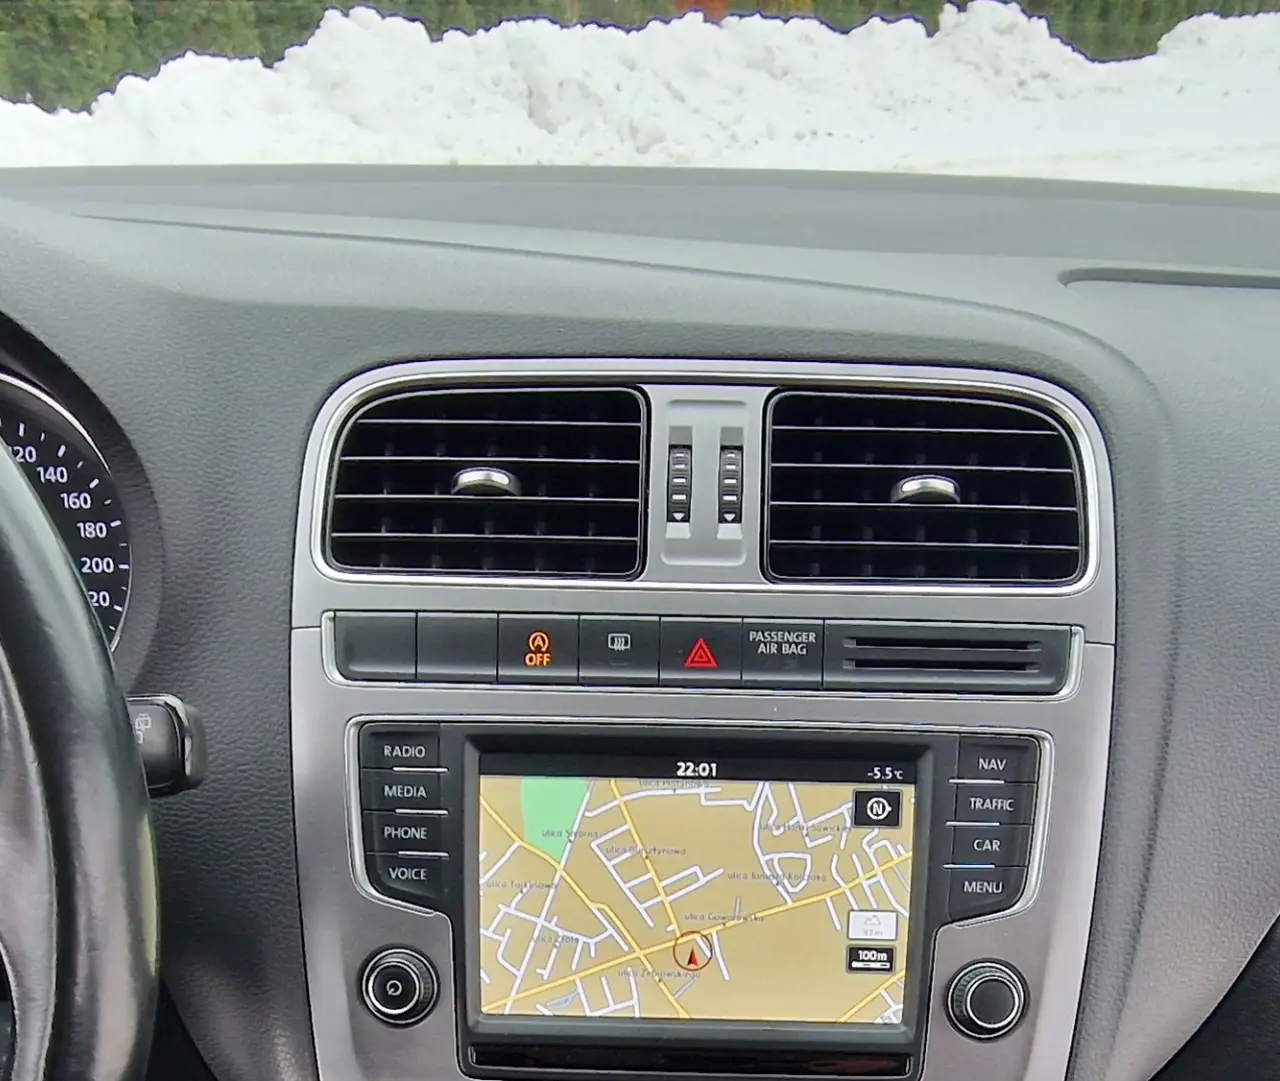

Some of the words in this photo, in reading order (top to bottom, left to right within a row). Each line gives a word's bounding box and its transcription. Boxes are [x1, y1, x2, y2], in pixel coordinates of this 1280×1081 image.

[10, 446, 37, 463] 20
[37, 466, 68, 483] 140
[60, 492, 91, 509] 160
[77, 522, 107, 538] 180
[80, 557, 114, 573] 200
[88, 591, 110, 607] 20
[749, 631, 816, 643] PASSENGER
[758, 643, 777, 654] AIR
[781, 644, 807, 655] BAG
[525, 653, 551, 666] OFF
[384, 745, 426, 758] RADIO
[676, 762, 718, 777] 22:01
[979, 758, 1006, 771] NAV
[384, 785, 427, 798] MEDIA
[969, 797, 1015, 811] TRAFFIC
[384, 826, 428, 839] PHONE
[542, 829, 562, 838] ulica
[973, 840, 1001, 852] CAR
[389, 867, 428, 880] VOICE
[964, 882, 1003, 893] MENU
[858, 951, 888, 961] 100m
